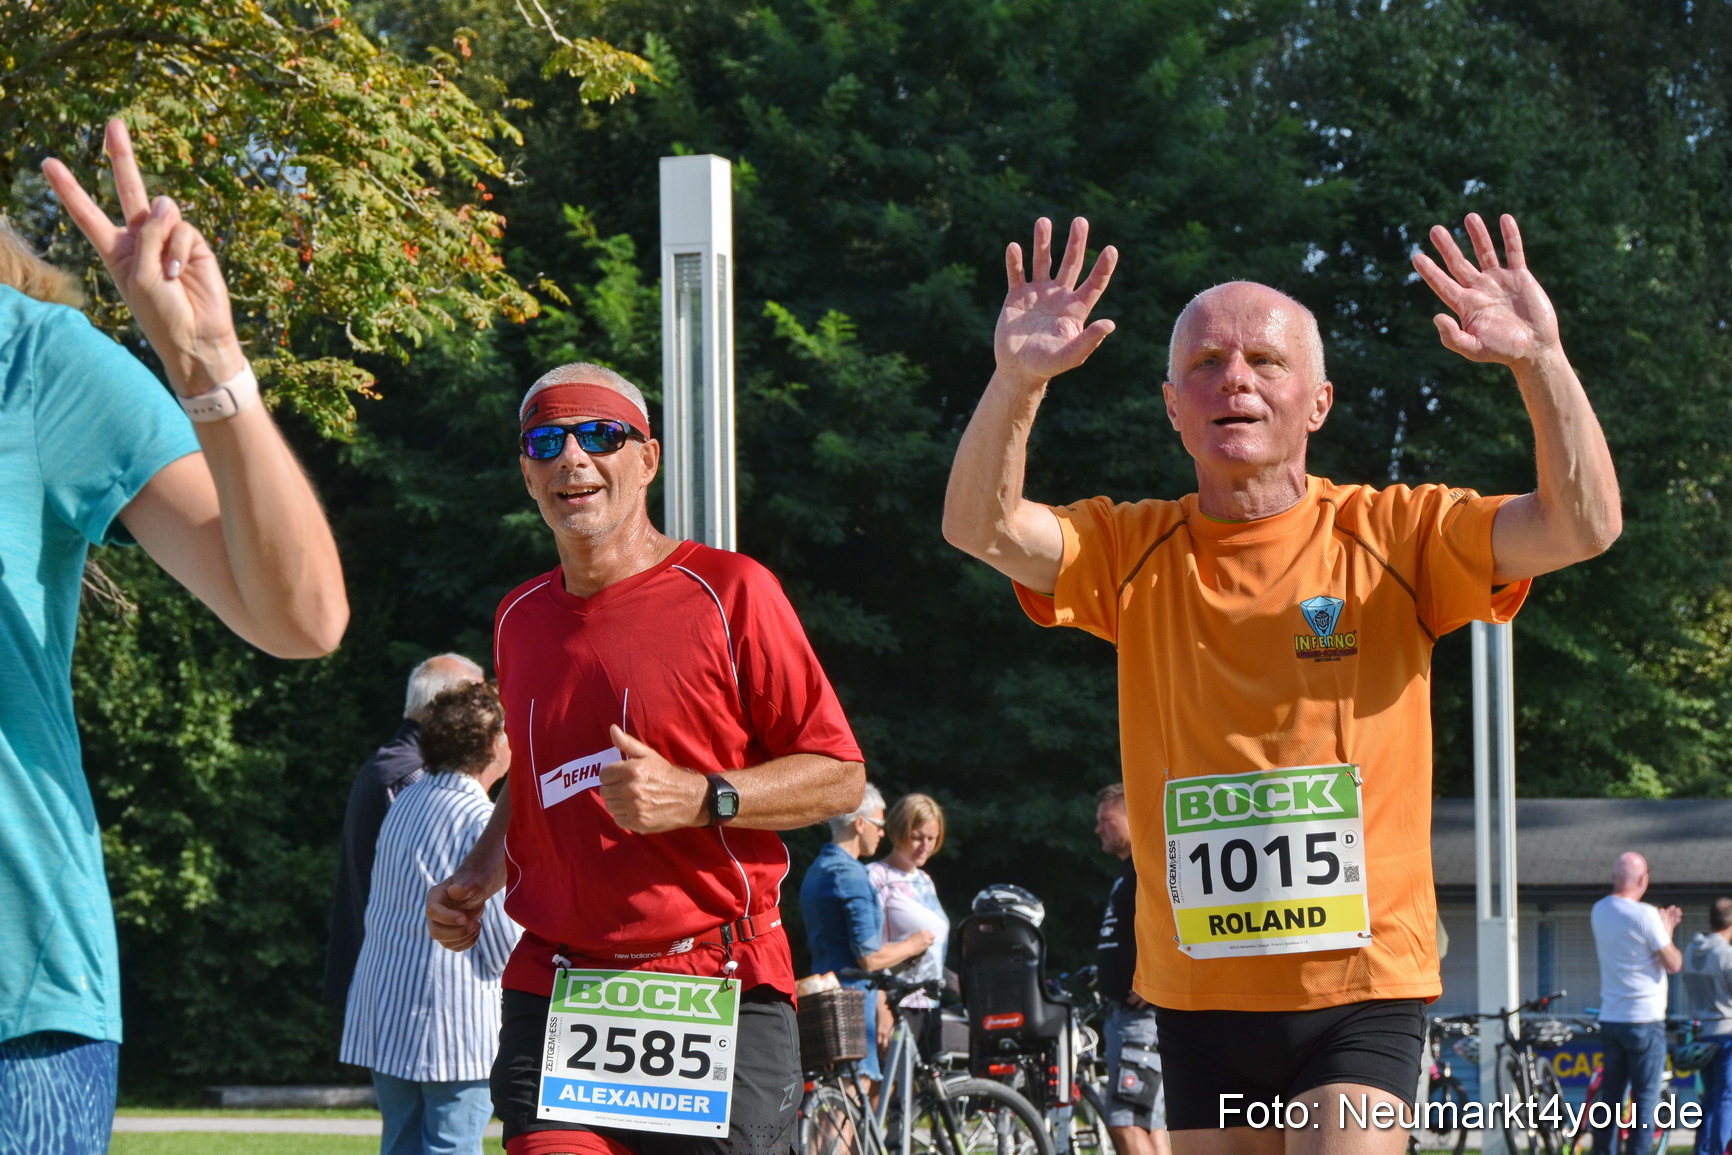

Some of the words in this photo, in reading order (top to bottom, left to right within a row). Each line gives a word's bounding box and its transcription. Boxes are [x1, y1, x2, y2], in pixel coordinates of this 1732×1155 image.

[1295, 632, 1356, 651] INFERNO
[563, 762, 601, 789] DEHN
[1176, 774, 1344, 827] BOCK
[1345, 834, 1354, 844] D
[1189, 832, 1340, 895] 1015
[1208, 906, 1326, 936] ROLAND
[565, 976, 721, 1019] BOCK
[566, 1023, 712, 1079] 2585
[718, 1039, 726, 1048] C
[558, 1084, 710, 1114] ALEXANDER
